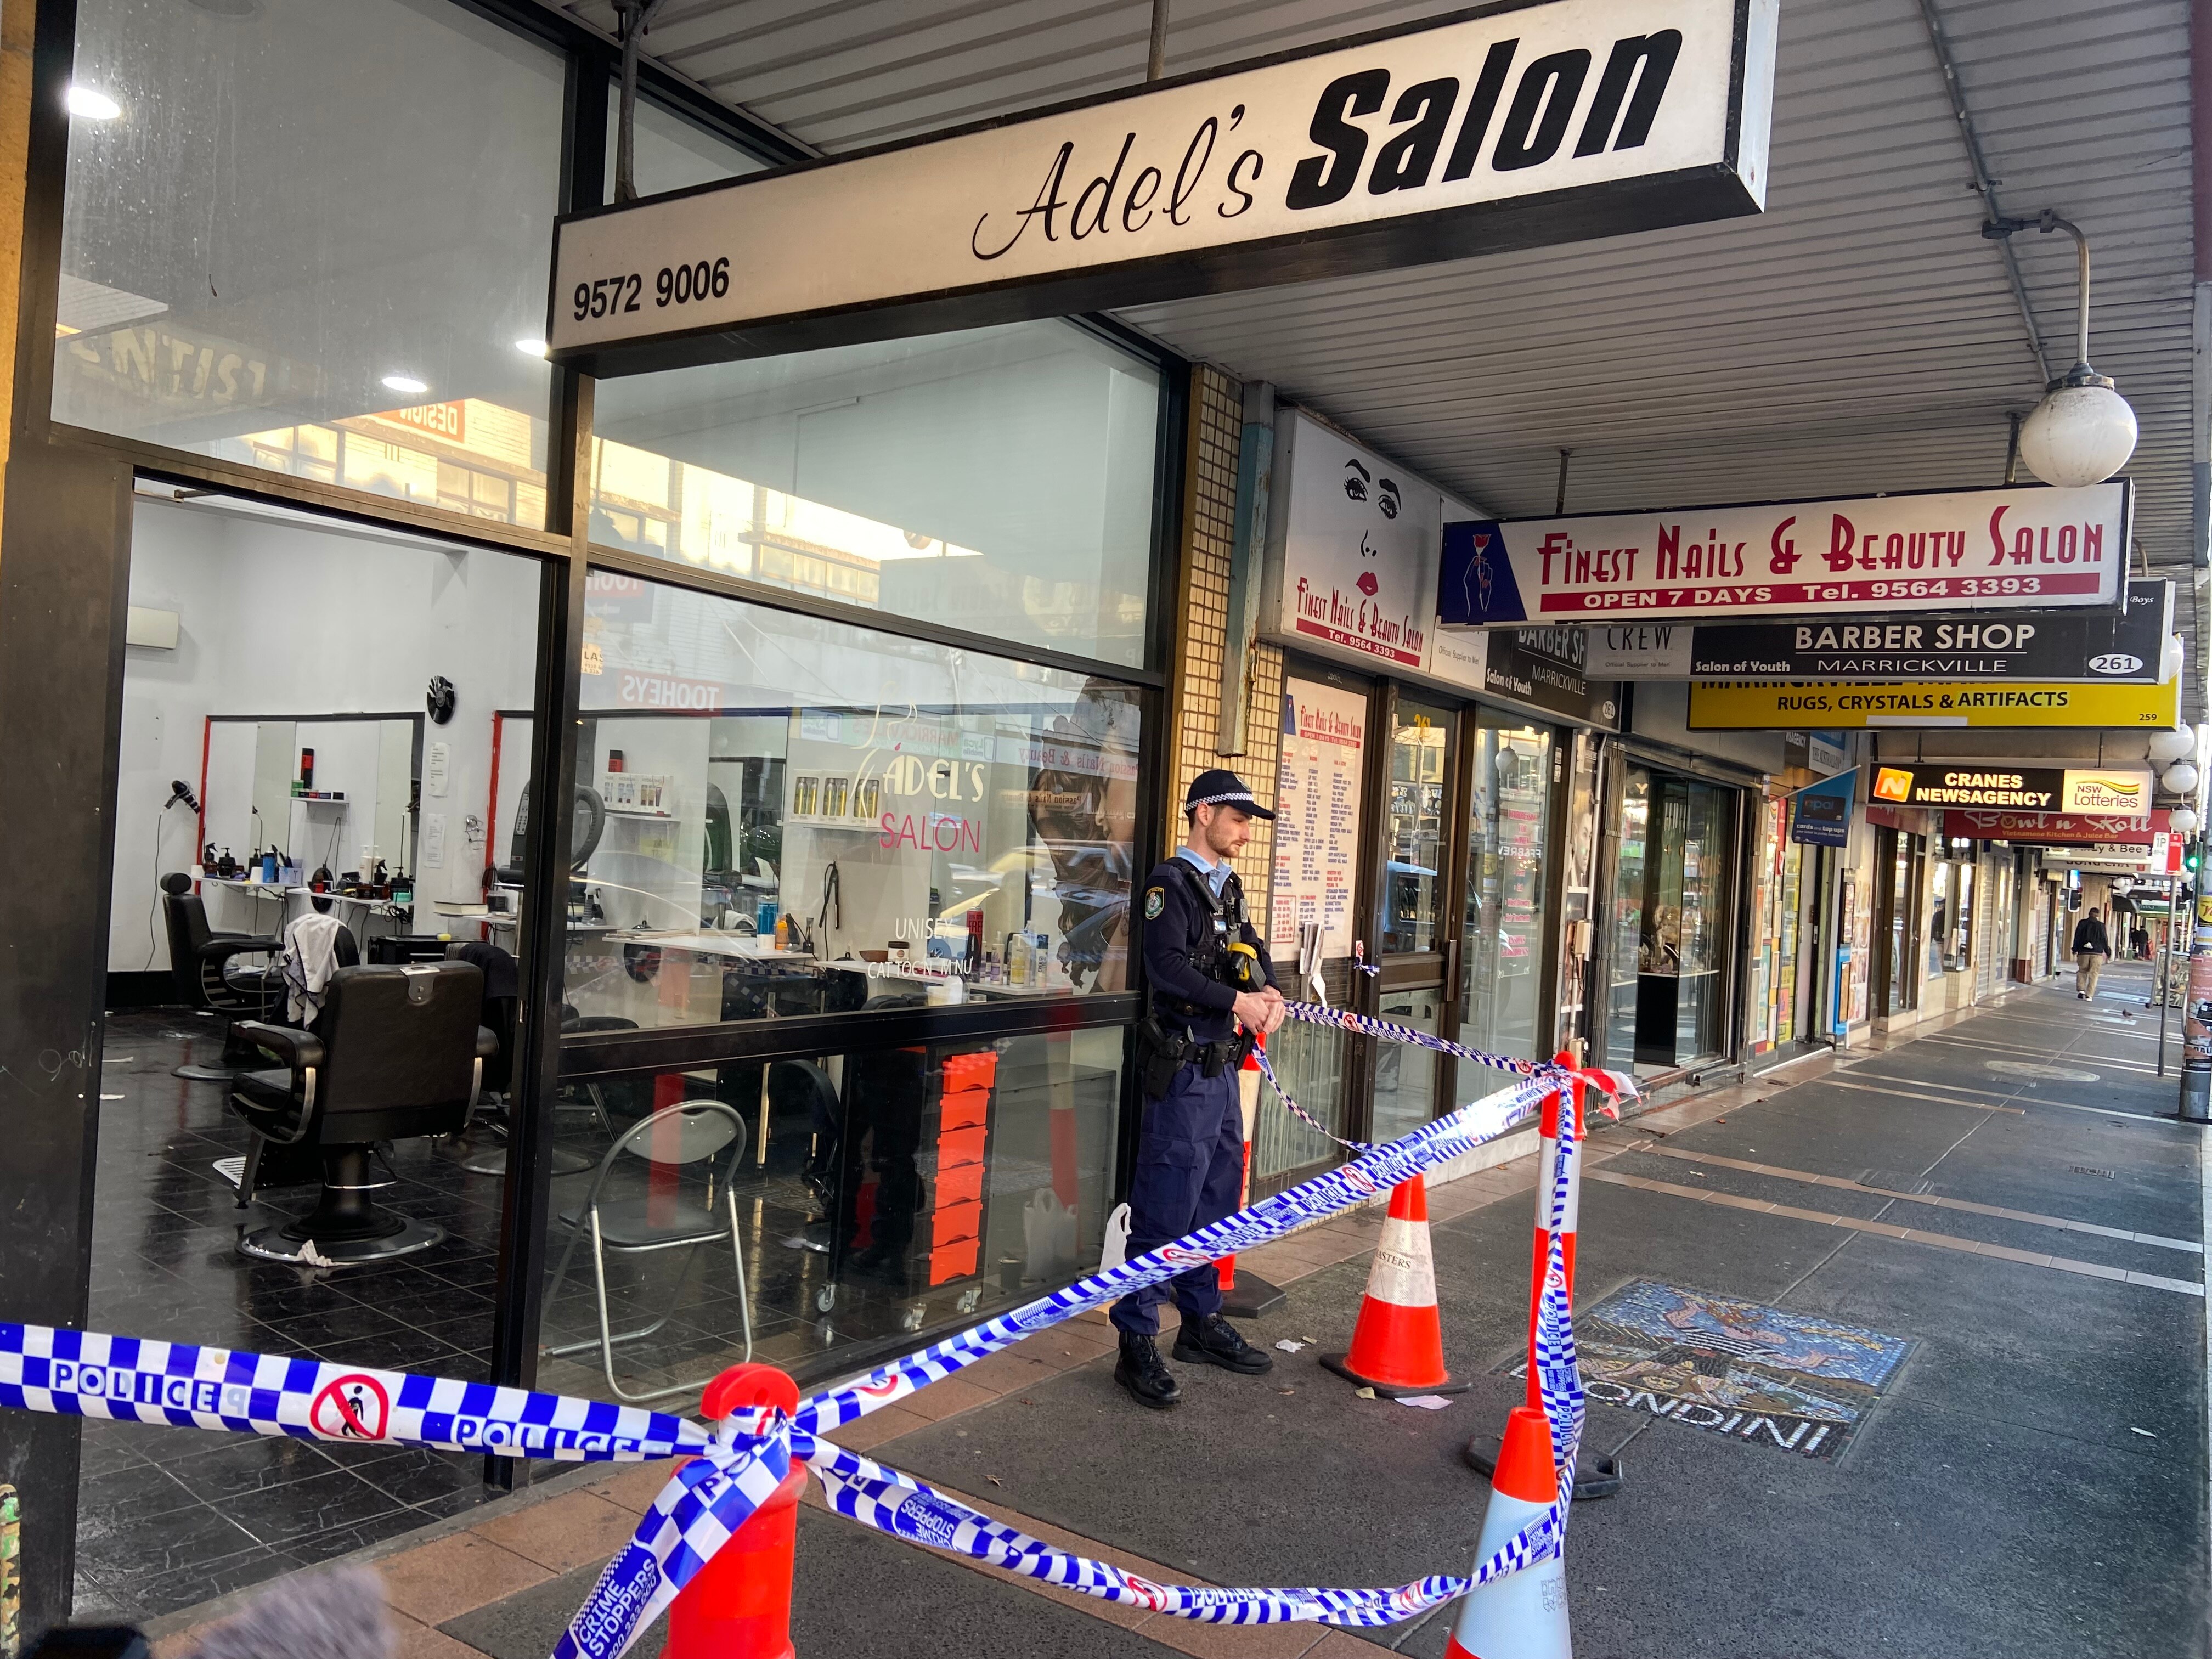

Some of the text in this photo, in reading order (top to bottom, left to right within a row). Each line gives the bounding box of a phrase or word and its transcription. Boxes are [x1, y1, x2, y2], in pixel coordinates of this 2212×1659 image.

[972, 27, 1684, 259] Adel's Salon
[574, 257, 731, 321] 9572 9006
[1770, 516, 1802, 574] &
[1821, 514, 1965, 572] BEAUTY
[1989, 505, 2102, 567] SALON
[1584, 578, 2041, 608] OPEN 7 DAYS Tel. 9564 3393
[2130, 595, 2154, 604] Boys
[1358, 599, 1367, 633] &
[1370, 602, 1400, 645] BEAUTY
[1402, 615, 1424, 652] SALON
[1607, 627, 1672, 650] CREW
[1795, 624, 2035, 650] BARBER SHOP
[1329, 630, 1395, 658] Tel. 9564 3393
[1696, 661, 1790, 672] Salon of Youth
[1818, 659, 2007, 673] MARRICKVILLE
[2096, 658, 2135, 670] 261
[1486, 668, 1504, 687] Salon
[1513, 676, 1532, 696] Youth
[1532, 664, 1585, 696] MARRICKVILLE
[1604, 702, 1615, 716] 261
[1778, 691, 2068, 712] RUGS, CRYSTALS & ARTIFACTS
[1944, 772, 2023, 789] CRANES
[2077, 785, 2102, 793] NSW
[1916, 788, 2051, 806] NEWSAGENCY
[2075, 793, 2138, 808] Lotteries
[879, 812, 981, 853] SALON
[2002, 830, 2045, 838] Vietnamese
[2056, 817, 2075, 830] n
[2084, 812, 2153, 833] Roll
[895, 917, 955, 940] UNISEX
[1368, 1025, 1408, 1040] POLICE
[1371, 1154, 1403, 1178] POLICE
[1304, 1185, 1340, 1211] POLICE
[1210, 1226, 1261, 1249] POLICE
[1544, 1301, 1562, 1348] POLICE
[55, 1363, 216, 1414] POLICE
[1557, 1406, 1575, 1446] POLICE
[900, 1499, 956, 1533] STOPPERS
[579, 1579, 624, 1645] CRIME
[589, 1558, 656, 1657] STOPPERS
[607, 1633, 625, 1659] 800
[624, 1607, 643, 1633] 333
